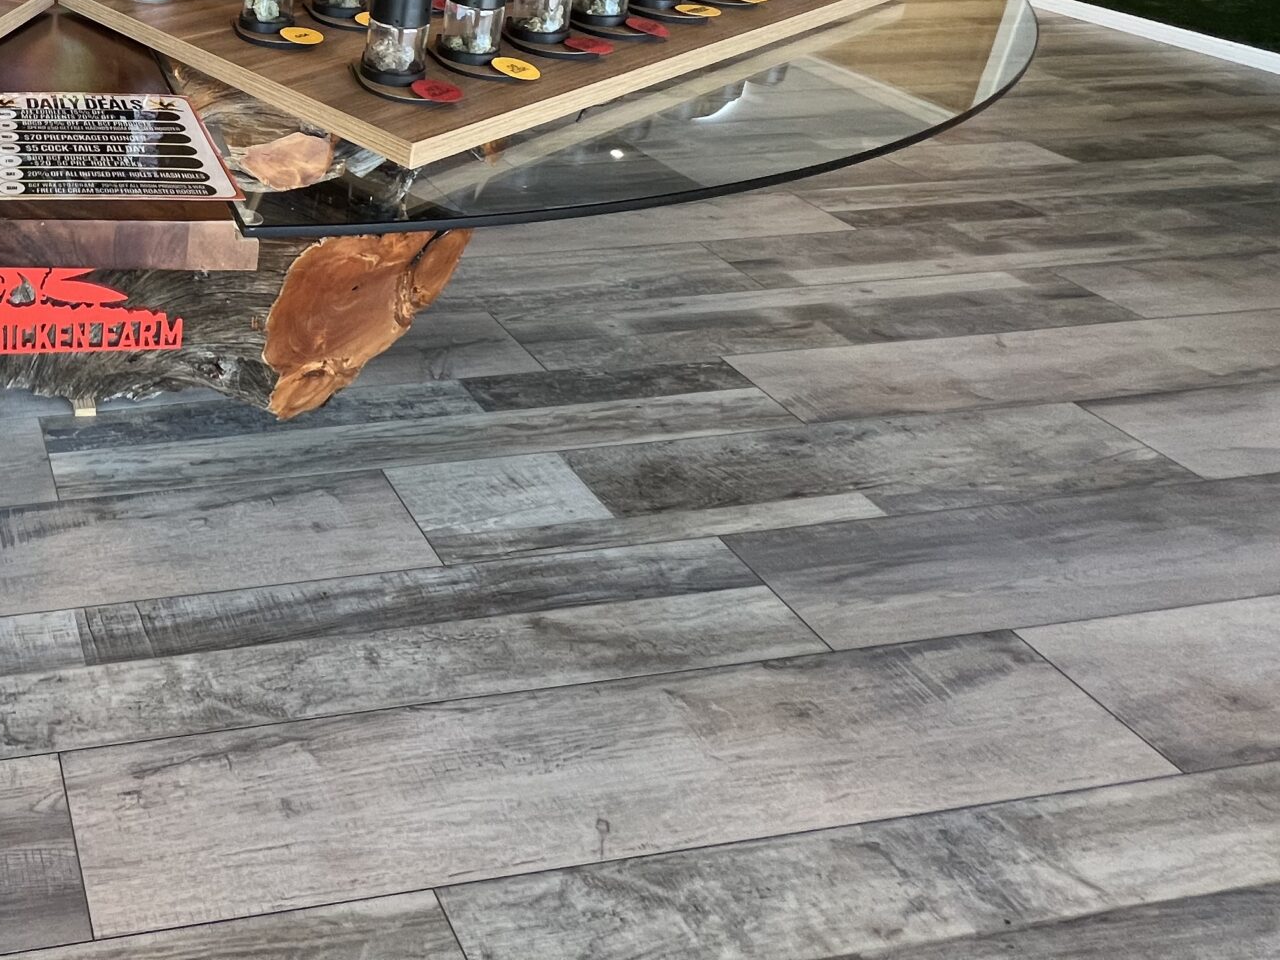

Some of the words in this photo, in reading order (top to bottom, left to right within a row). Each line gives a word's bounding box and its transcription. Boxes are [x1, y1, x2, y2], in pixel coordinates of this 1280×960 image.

[26, 97, 80, 110] DAILY
[84, 97, 143, 111] DEALS
[24, 133, 42, 141] $70
[43, 133, 109, 141] PREPACKAGED
[25, 144, 39, 152] $5
[41, 144, 101, 152] COCK-TAILS
[106, 145, 125, 153] ALL
[125, 145, 146, 153] DAY
[101, 318, 183, 352] FARM
